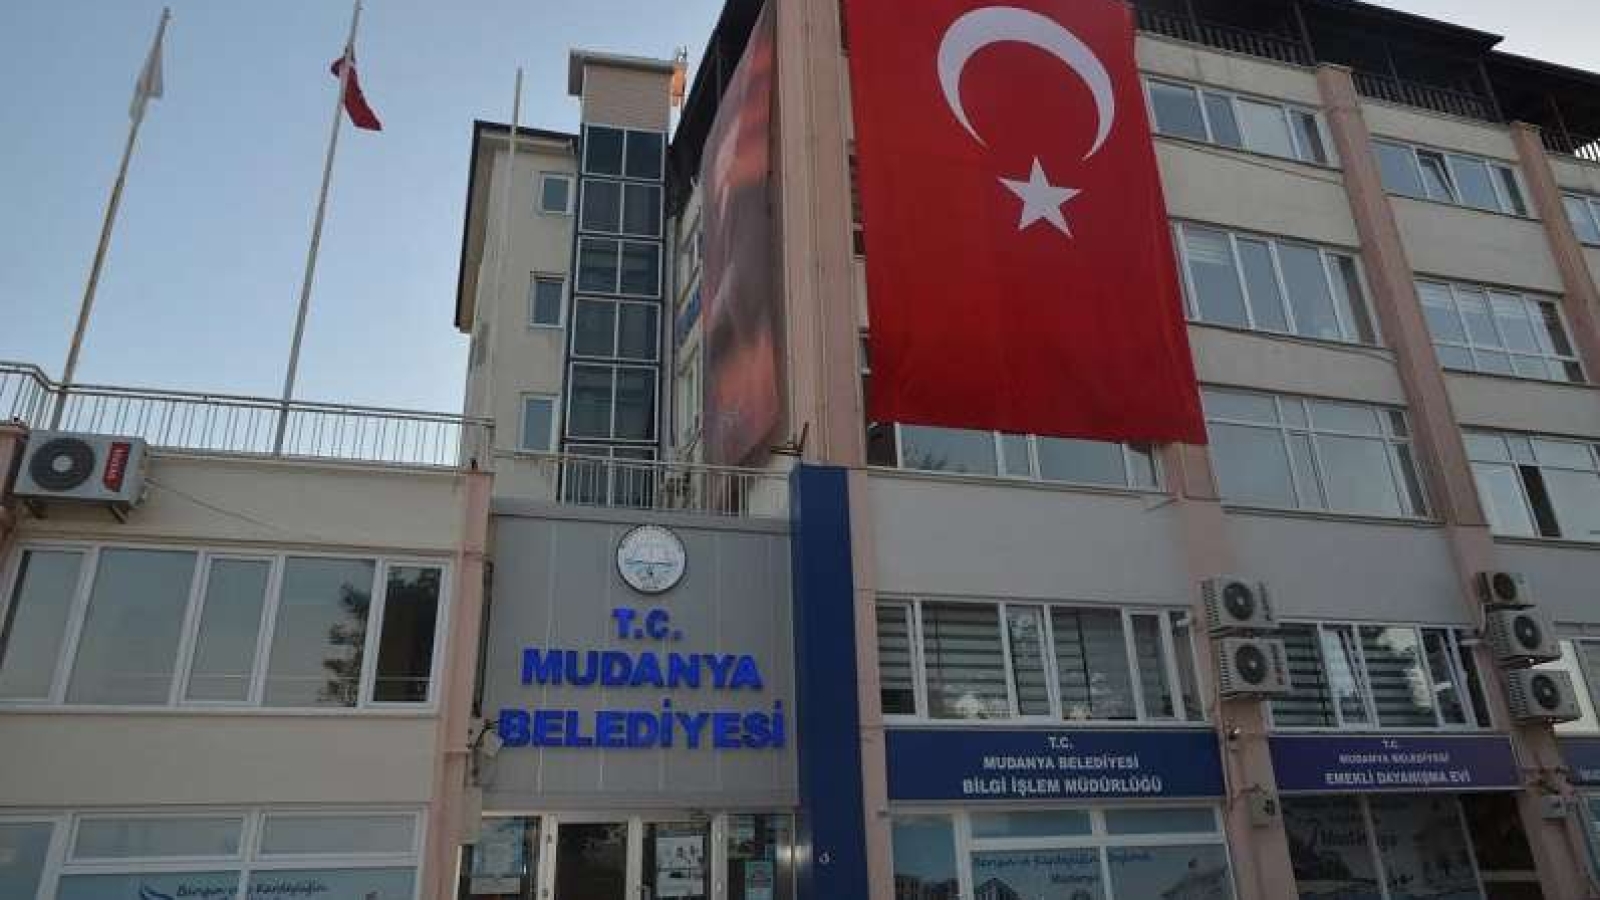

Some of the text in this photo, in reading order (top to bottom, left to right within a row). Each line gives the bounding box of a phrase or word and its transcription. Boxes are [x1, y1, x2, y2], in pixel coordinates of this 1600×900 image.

[612, 608, 682, 640] T.C.
[521, 648, 763, 690] MUDANYA
[499, 699, 786, 749] BELEDİYESİ
[1048, 736, 1073, 749] T.C.
[983, 753, 1139, 769] MUDANYA BELEDİYESİ
[963, 775, 1163, 796] BİLGİ İŞLEM MÜDÜRLÜĞÜ
[1325, 770, 1374, 784] EMEKLİ
